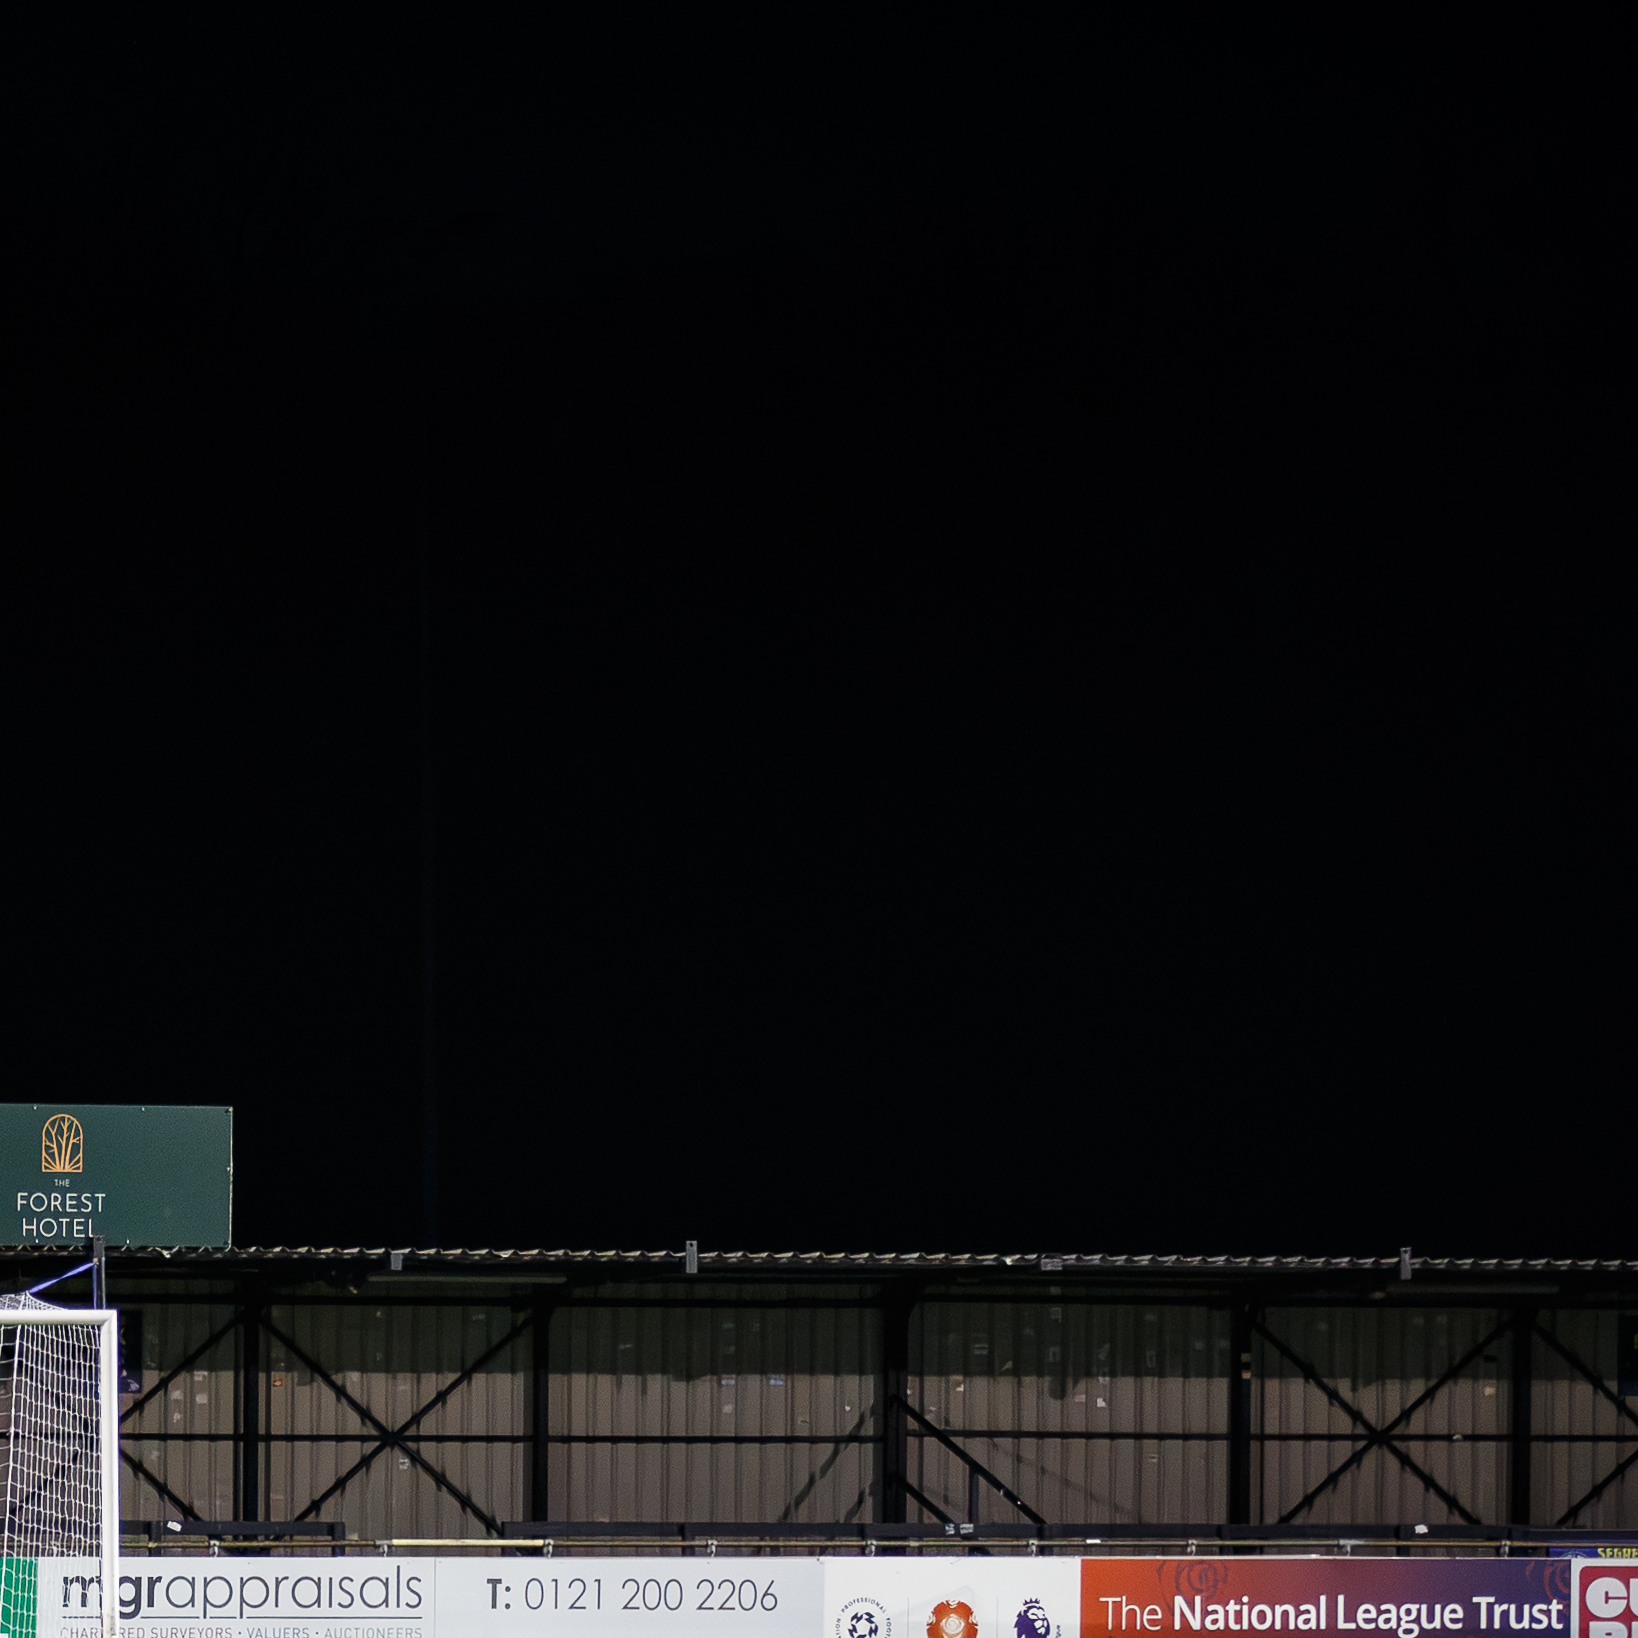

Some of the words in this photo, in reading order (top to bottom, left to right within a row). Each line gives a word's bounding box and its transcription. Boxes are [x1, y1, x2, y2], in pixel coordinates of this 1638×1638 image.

[54, 1179, 71, 1188] THE
[16, 1192, 107, 1213] FOREST
[22, 1218, 95, 1238] HOTEL
[486, 1578, 512, 1610] T:
[524, 1577, 602, 1611] 0121
[621, 1577, 684, 1611] 200
[695, 1578, 779, 1612] 2206
[1585, 1576, 1638, 1619] C
[1099, 1595, 1162, 1631] The
[1173, 1594, 1327, 1631] National
[1472, 1595, 1564, 1631] Trust
